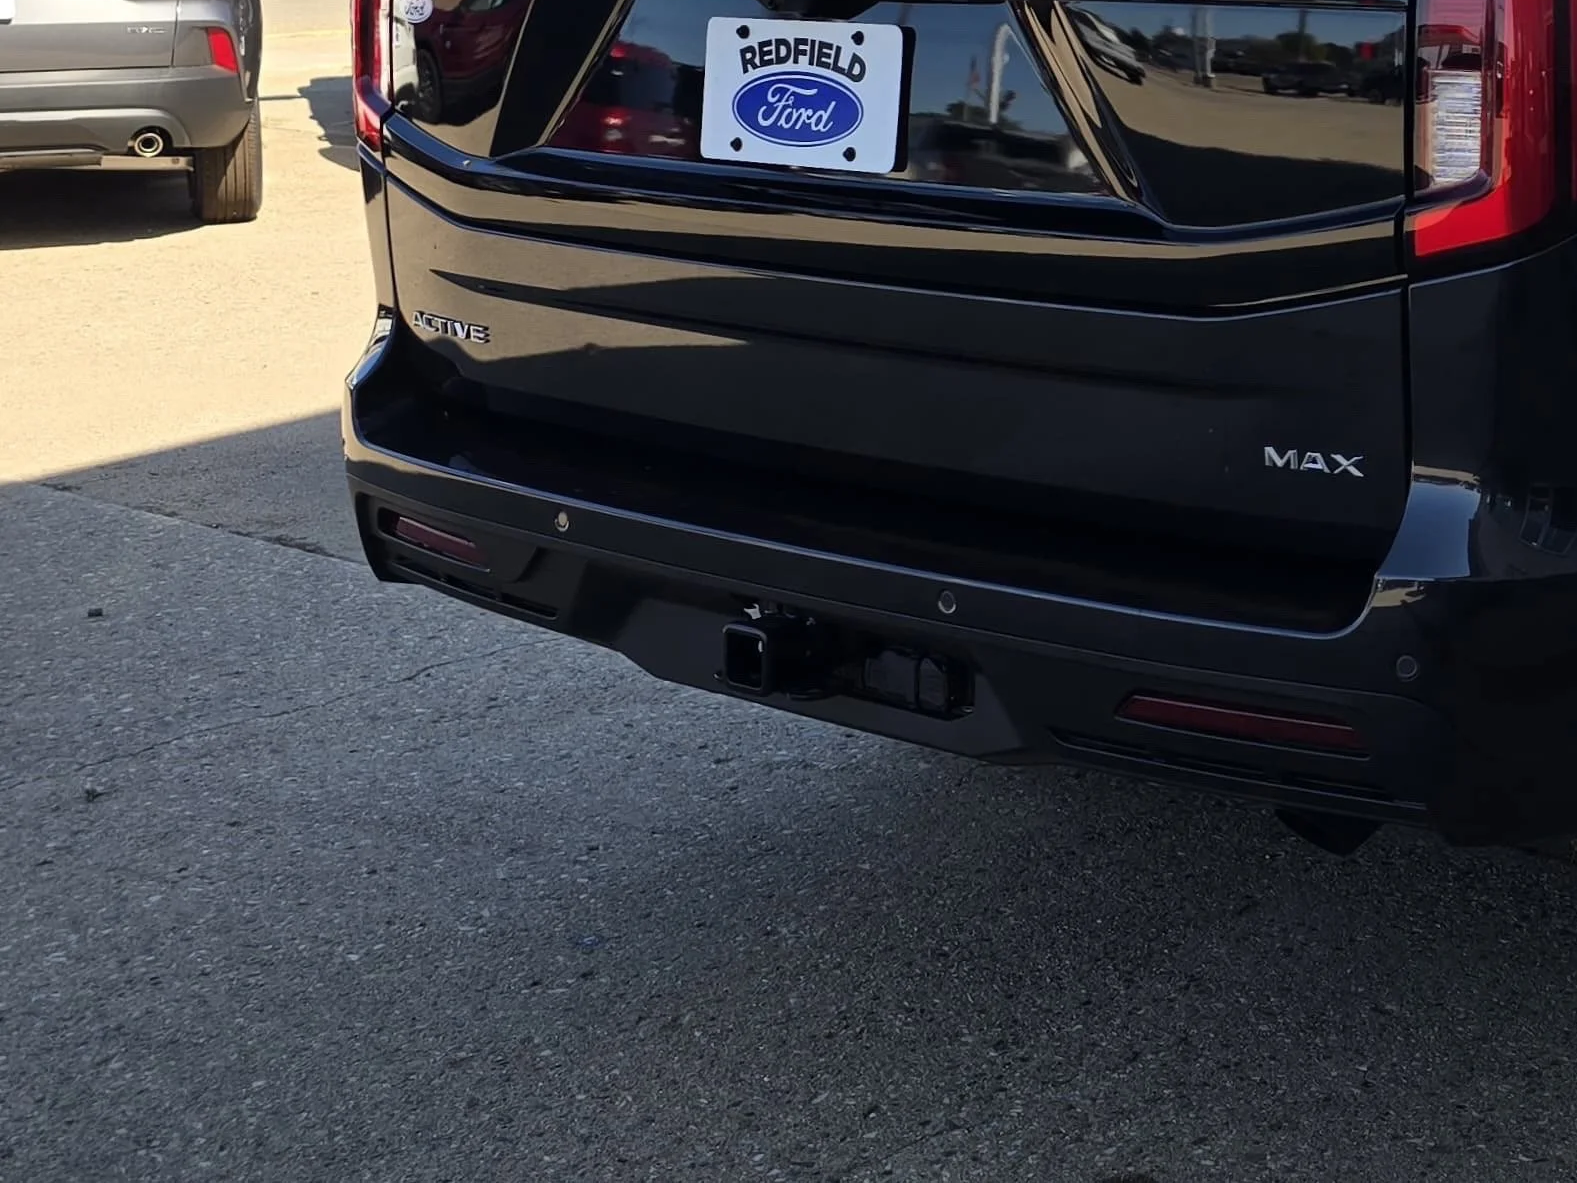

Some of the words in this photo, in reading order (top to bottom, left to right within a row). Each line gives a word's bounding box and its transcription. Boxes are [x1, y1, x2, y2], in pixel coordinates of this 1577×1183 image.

[739, 37, 866, 83] REDFIELD
[756, 82, 837, 134] Ford
[412, 310, 490, 344] ACTIVE
[1263, 446, 1364, 478] MAX
